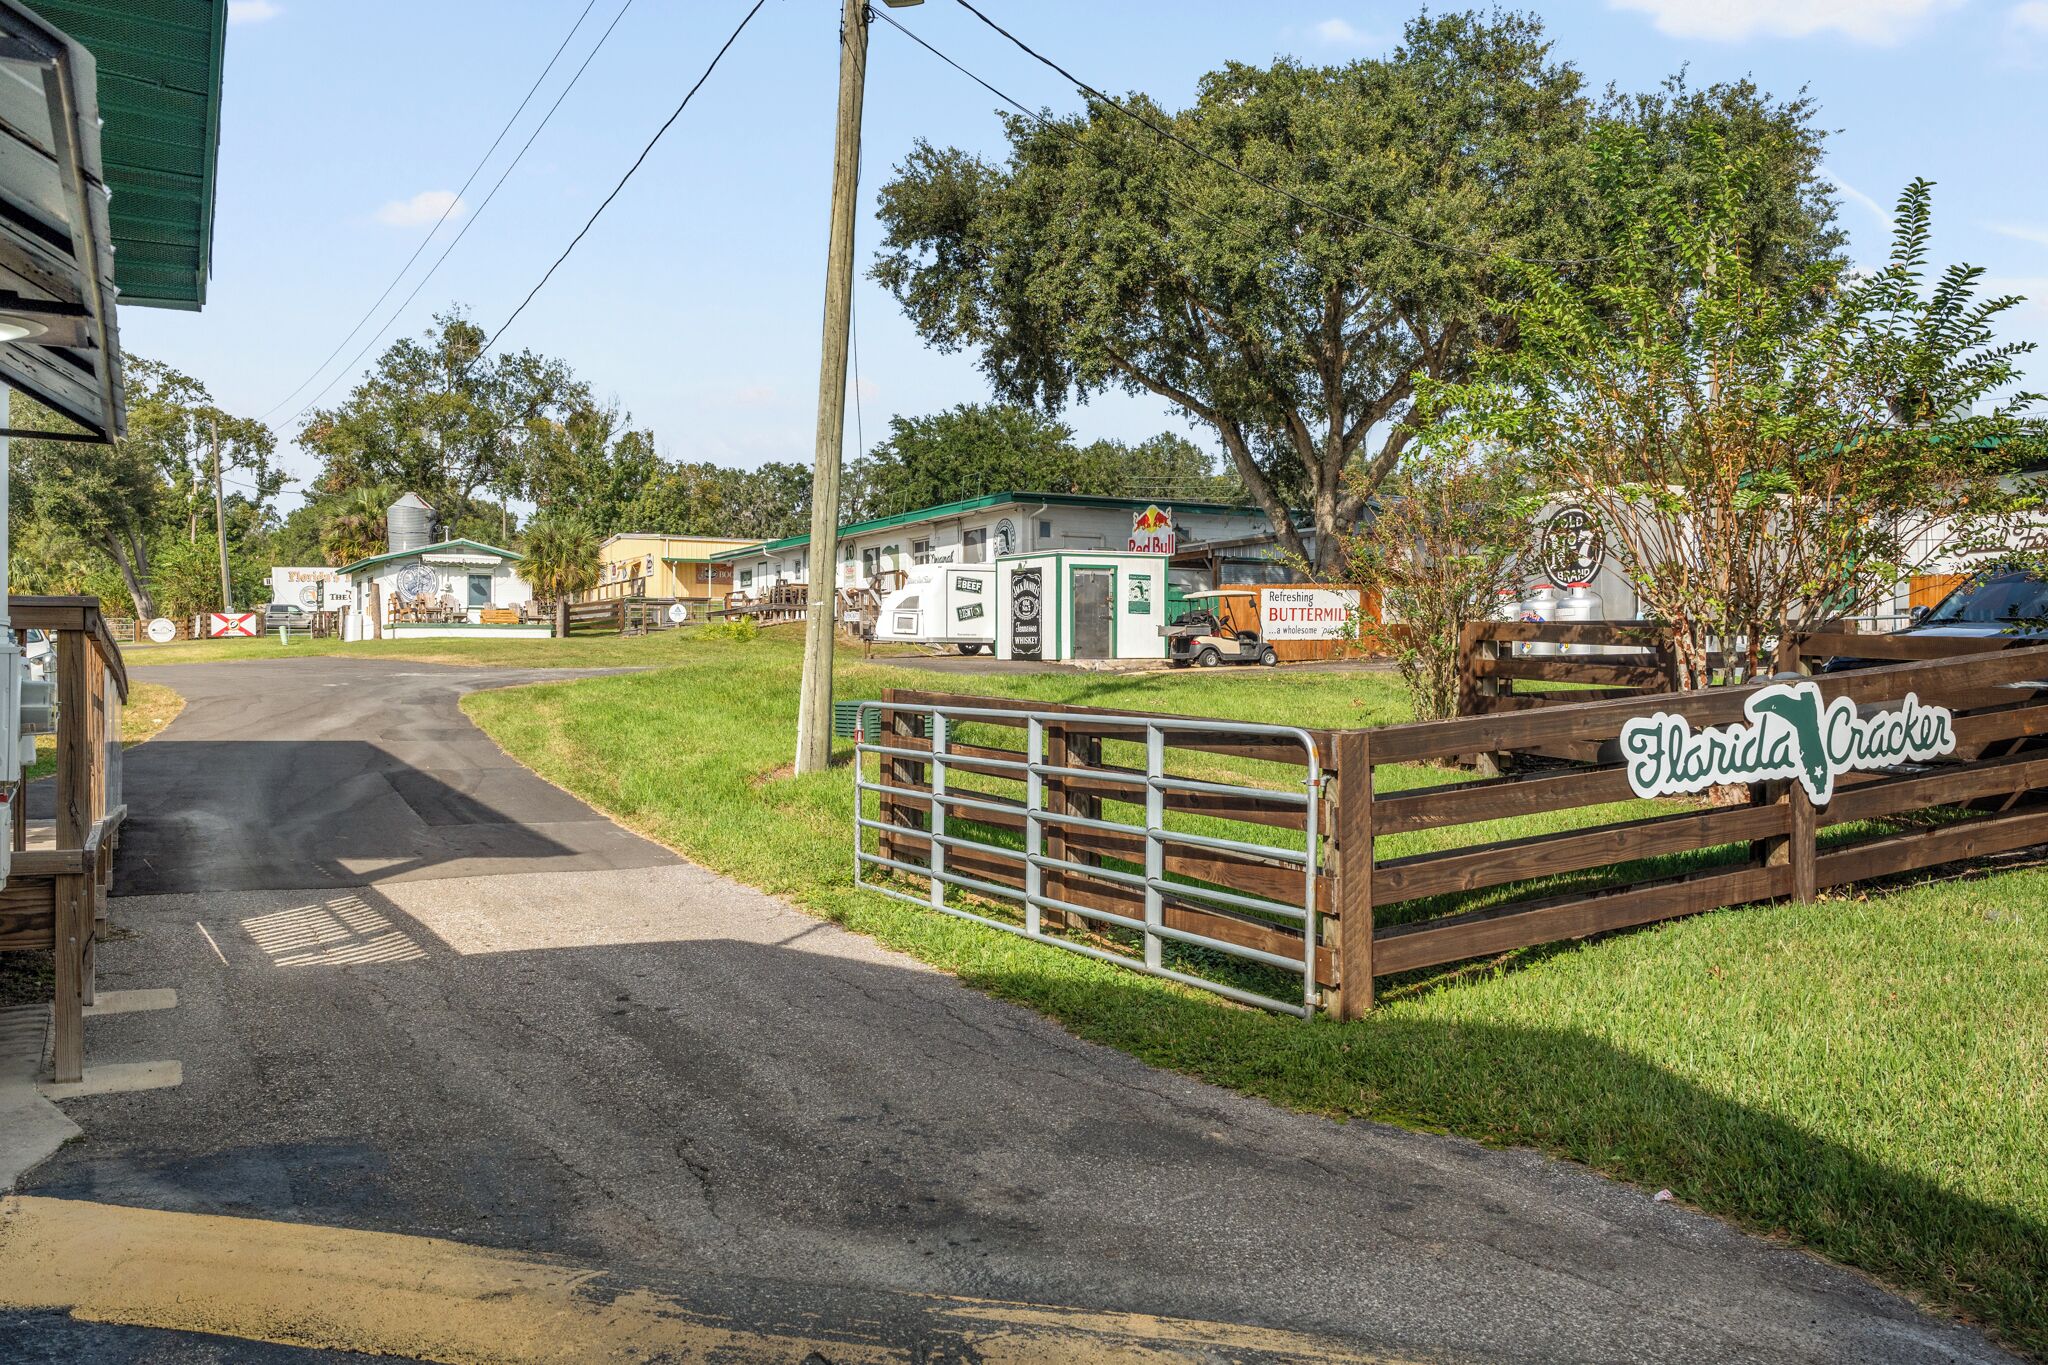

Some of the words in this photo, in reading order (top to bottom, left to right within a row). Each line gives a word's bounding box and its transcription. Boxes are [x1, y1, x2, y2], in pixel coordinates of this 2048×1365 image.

[1128, 537, 1151, 553] Red
[1152, 533, 1175, 554] Bull
[961, 580, 982, 591] BEEF
[1269, 591, 1314, 607] Refreshing
[1283, 625, 1317, 635] wholesome
[1014, 636, 1038, 645] WHISKEY
[1627, 712, 1796, 790] Florida
[1827, 701, 1950, 765] Cracker
